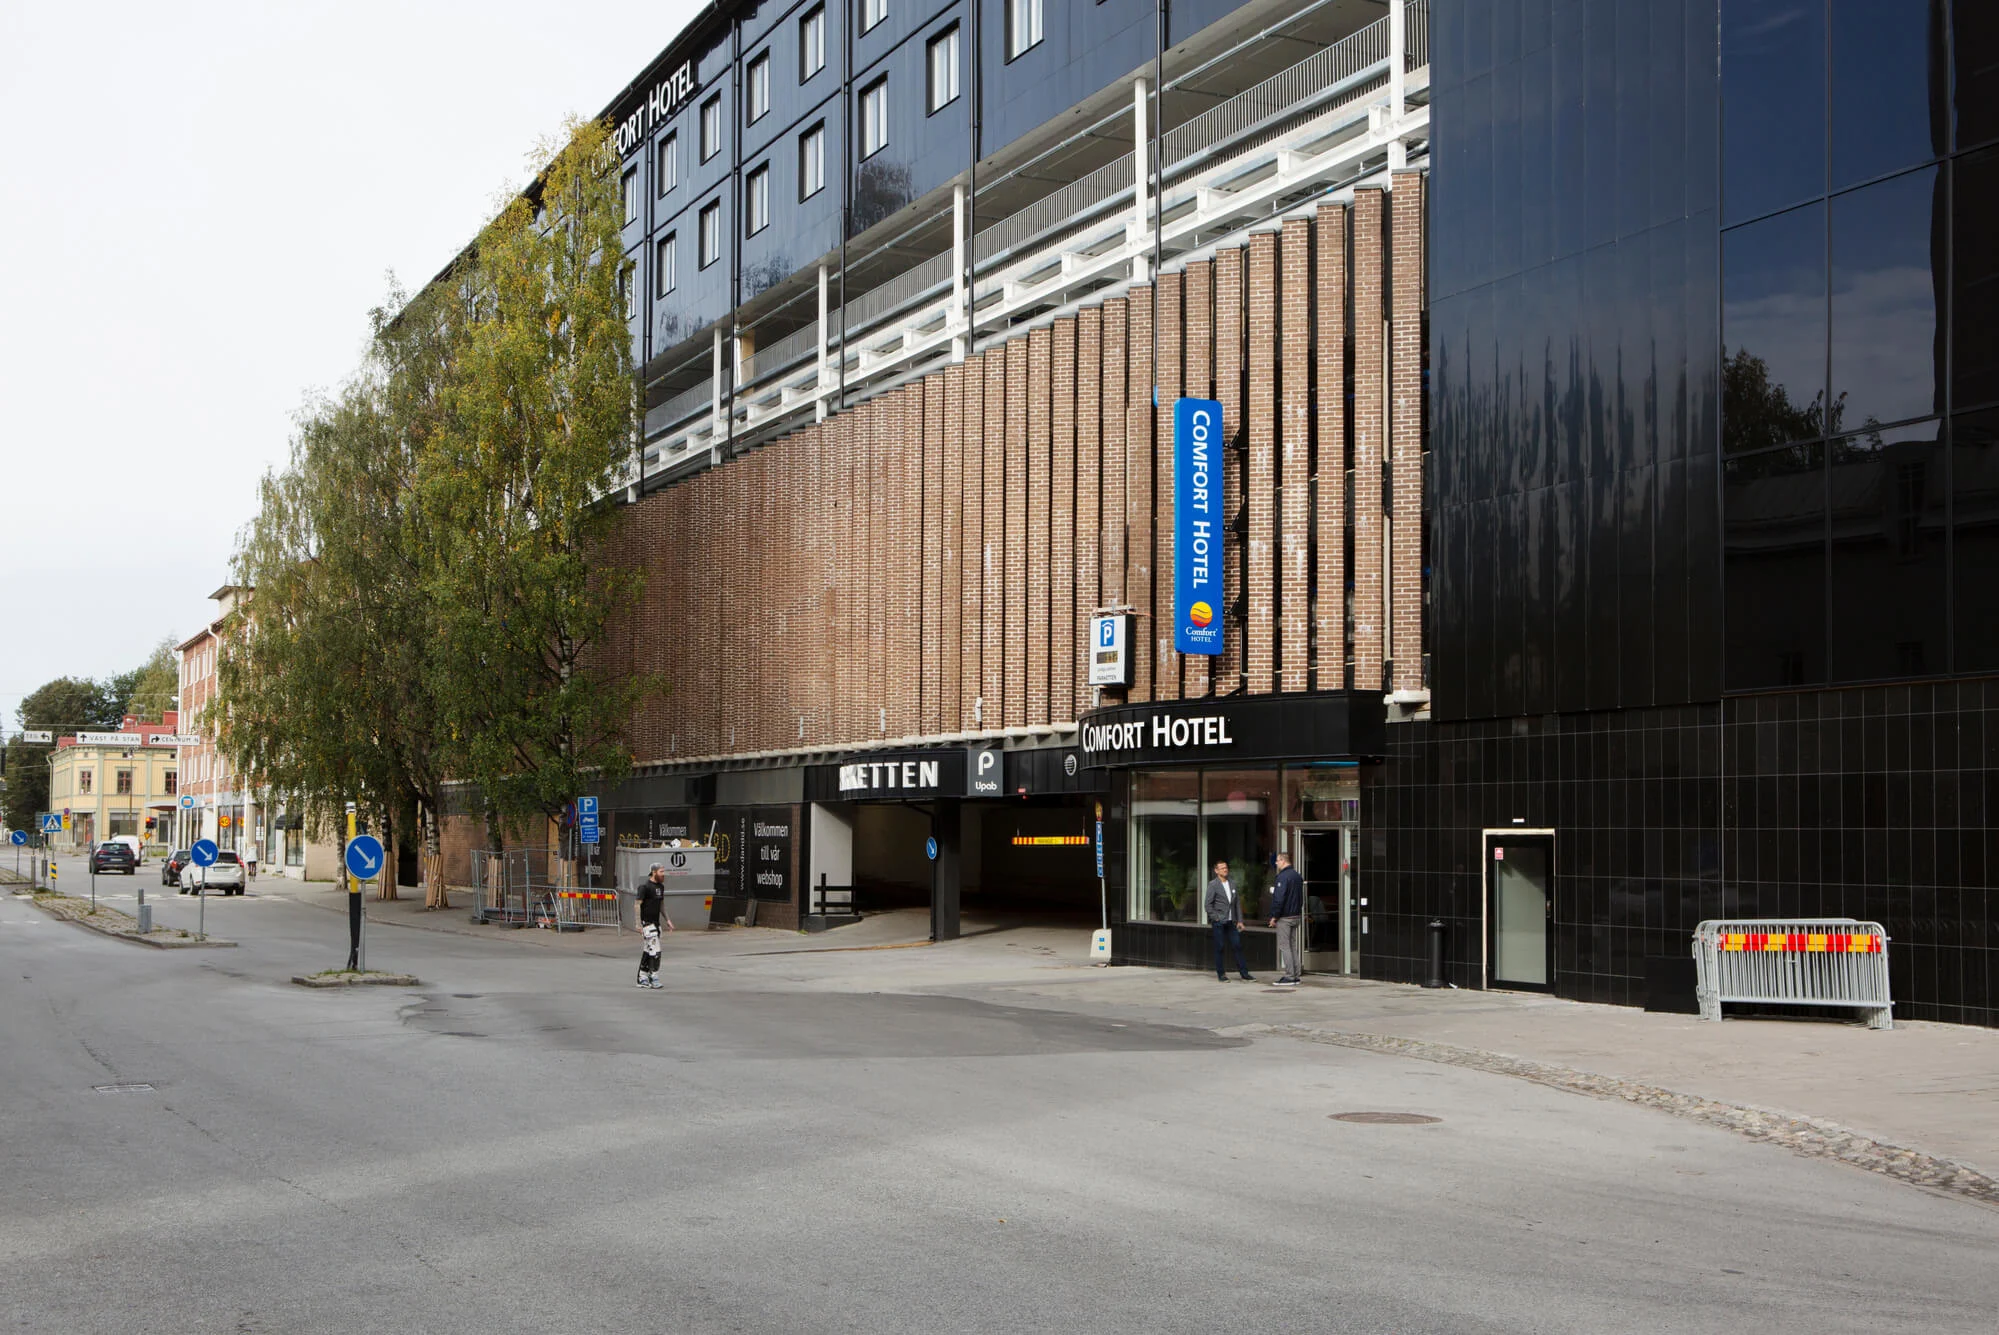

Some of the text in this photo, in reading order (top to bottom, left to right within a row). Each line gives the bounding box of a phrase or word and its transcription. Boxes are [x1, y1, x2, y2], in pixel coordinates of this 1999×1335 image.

[592, 59, 694, 176] FORT HOTEL
[1192, 410, 1211, 589] COMFORT HOTEL
[1104, 625, 1112, 645] P
[1185, 626, 1216, 637] Comfort
[1082, 715, 1233, 753] COMFORT HOTEL
[975, 781, 998, 792] Upab
[583, 799, 593, 812] P
[753, 822, 789, 837] Välkommen
[760, 844, 781, 861] till vår
[757, 869, 783, 889] webshop
